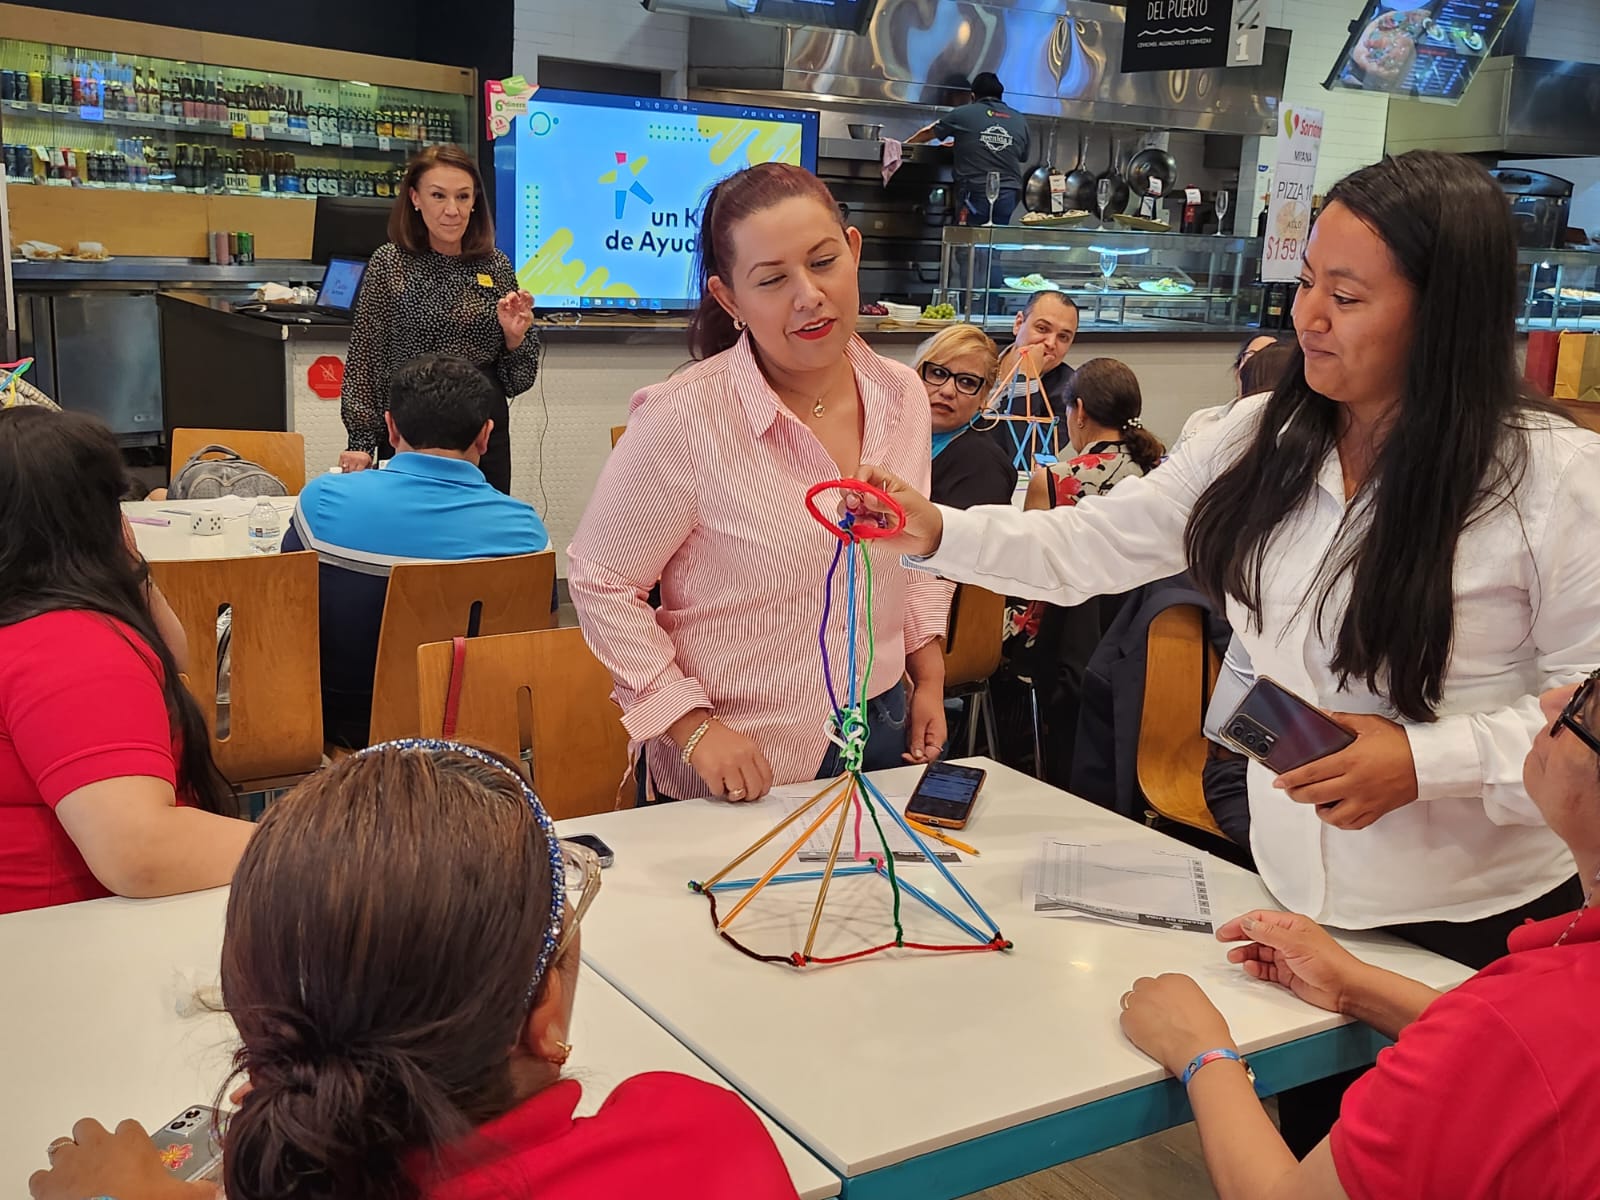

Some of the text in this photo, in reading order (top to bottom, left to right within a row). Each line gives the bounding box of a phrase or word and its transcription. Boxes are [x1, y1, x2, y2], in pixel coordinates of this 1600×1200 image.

[1147, 0, 1208, 21] DEL PUERTO
[1235, 33, 1249, 62] 1
[1277, 181, 1304, 201] PIZZA
[651, 211, 678, 228] un
[605, 229, 634, 251] de
